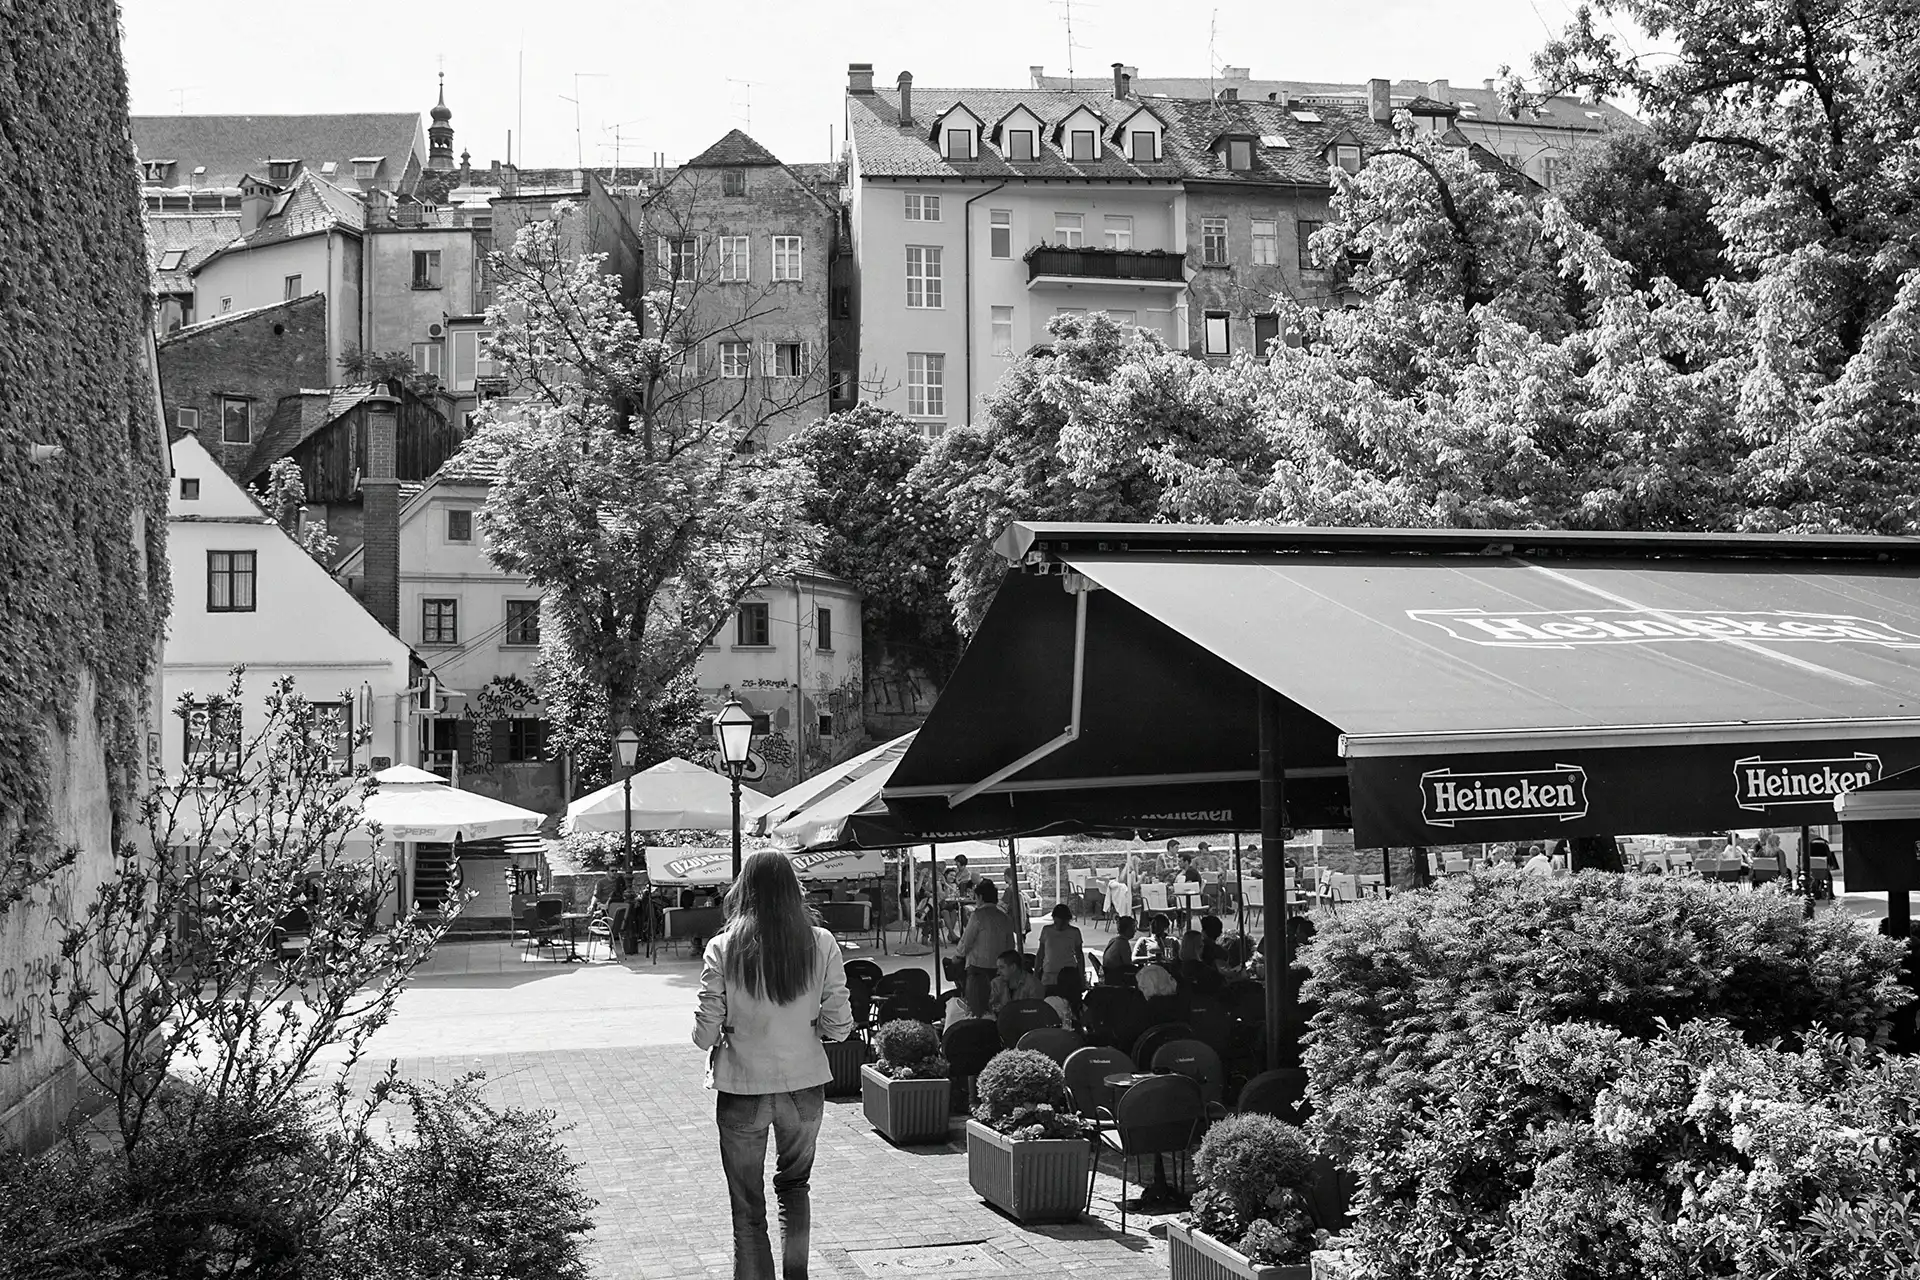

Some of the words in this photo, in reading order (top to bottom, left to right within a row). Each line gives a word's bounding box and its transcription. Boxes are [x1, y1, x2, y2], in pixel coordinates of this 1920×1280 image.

[1453, 616, 1902, 641] Heineken
[1433, 779, 1576, 812] Heineken
[1746, 766, 1871, 798] Heineken
[404, 827, 437, 837] PEPSI
